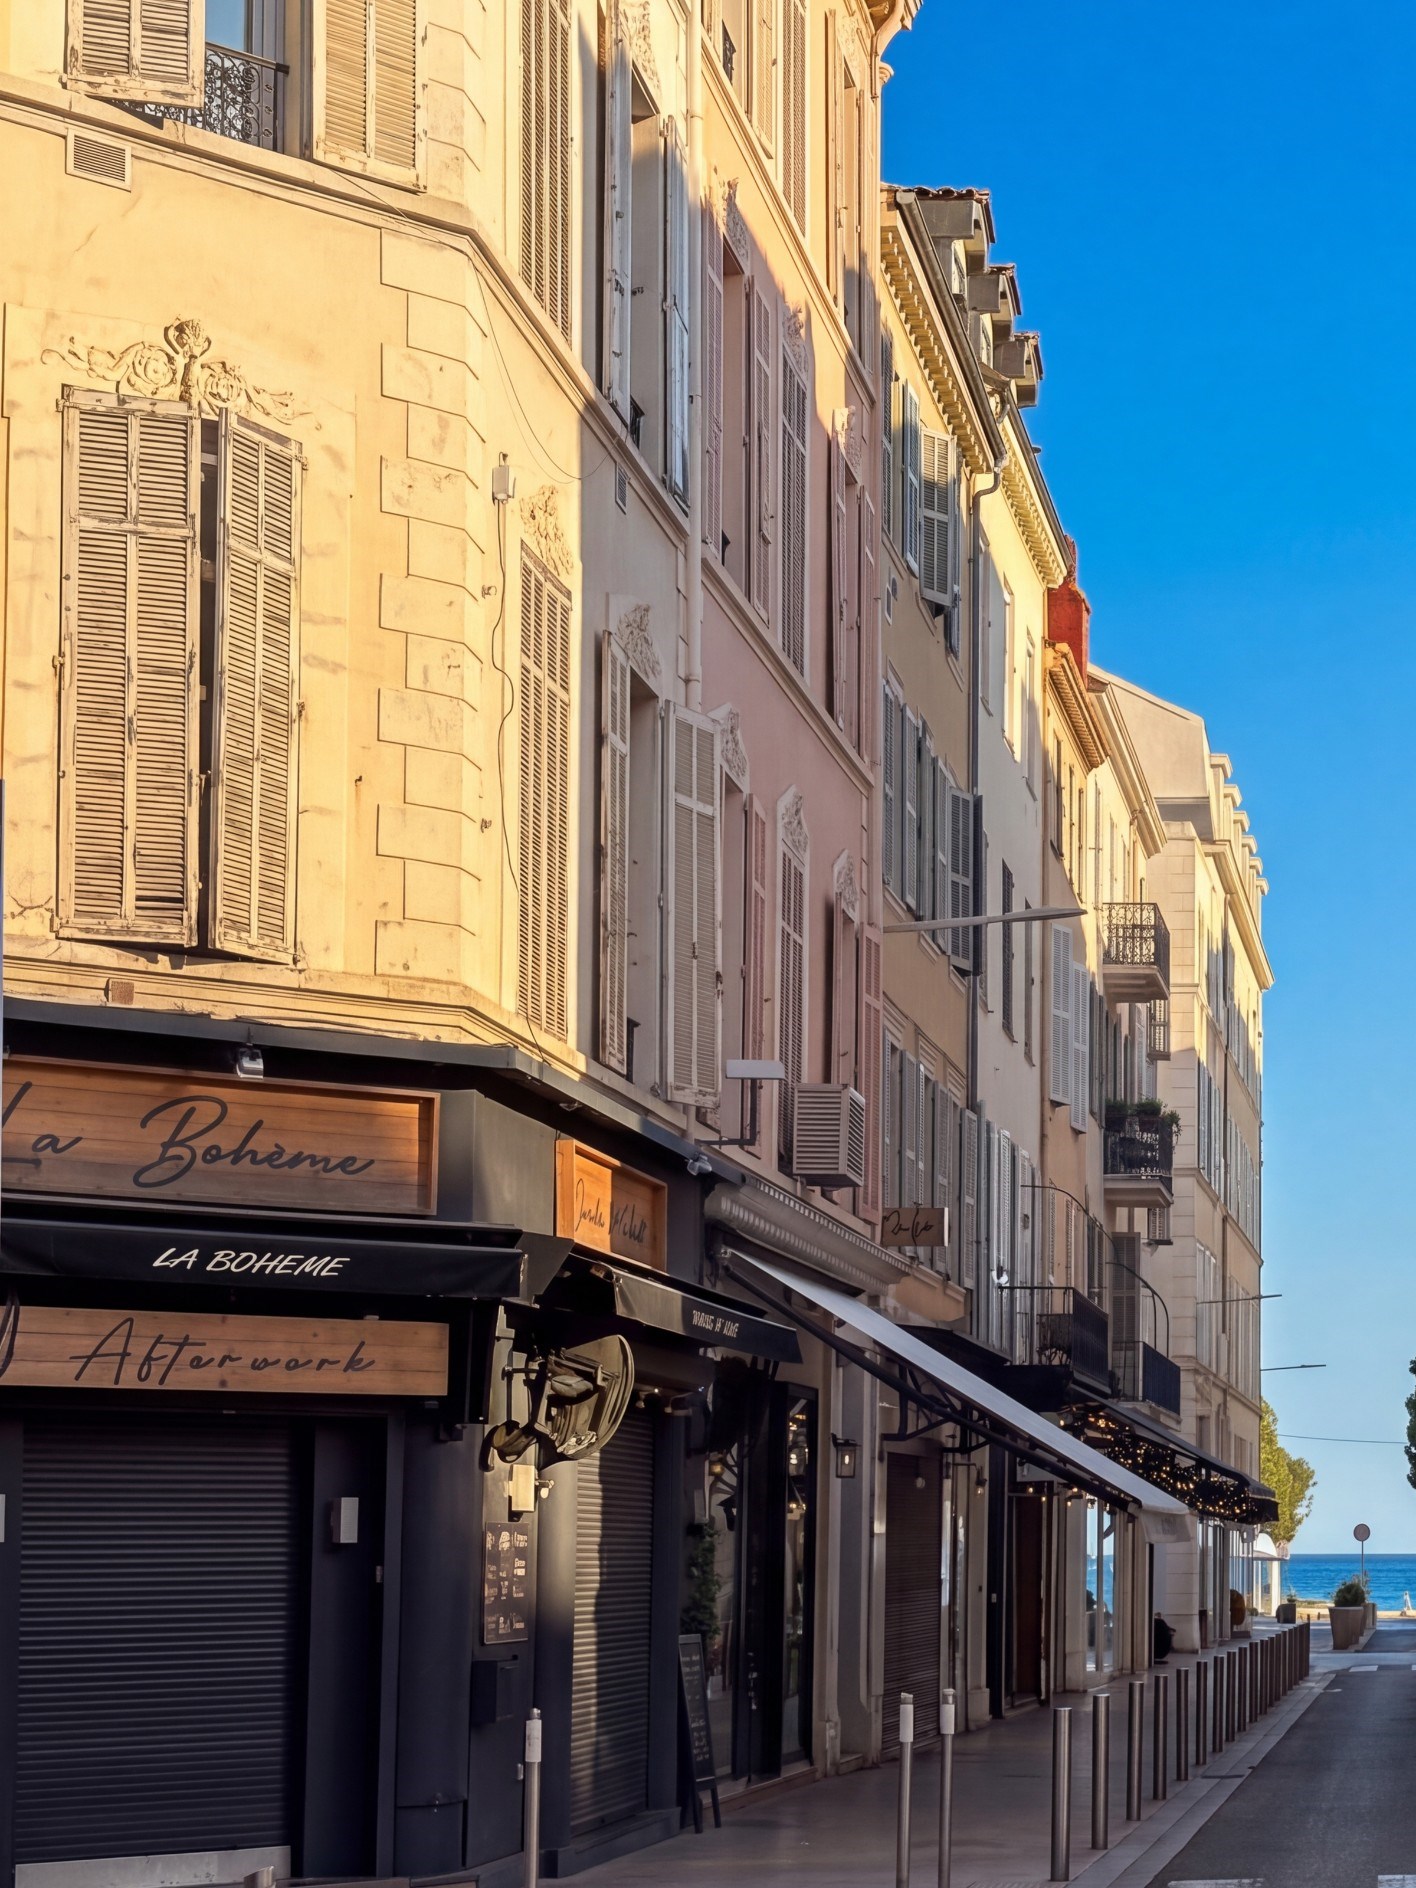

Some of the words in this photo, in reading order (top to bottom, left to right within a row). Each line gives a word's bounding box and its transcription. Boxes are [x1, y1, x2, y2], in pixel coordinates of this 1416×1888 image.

[133, 1095, 375, 1188] Bohème
[152, 1247, 200, 1269] LA
[206, 1249, 351, 1277] BOHEME
